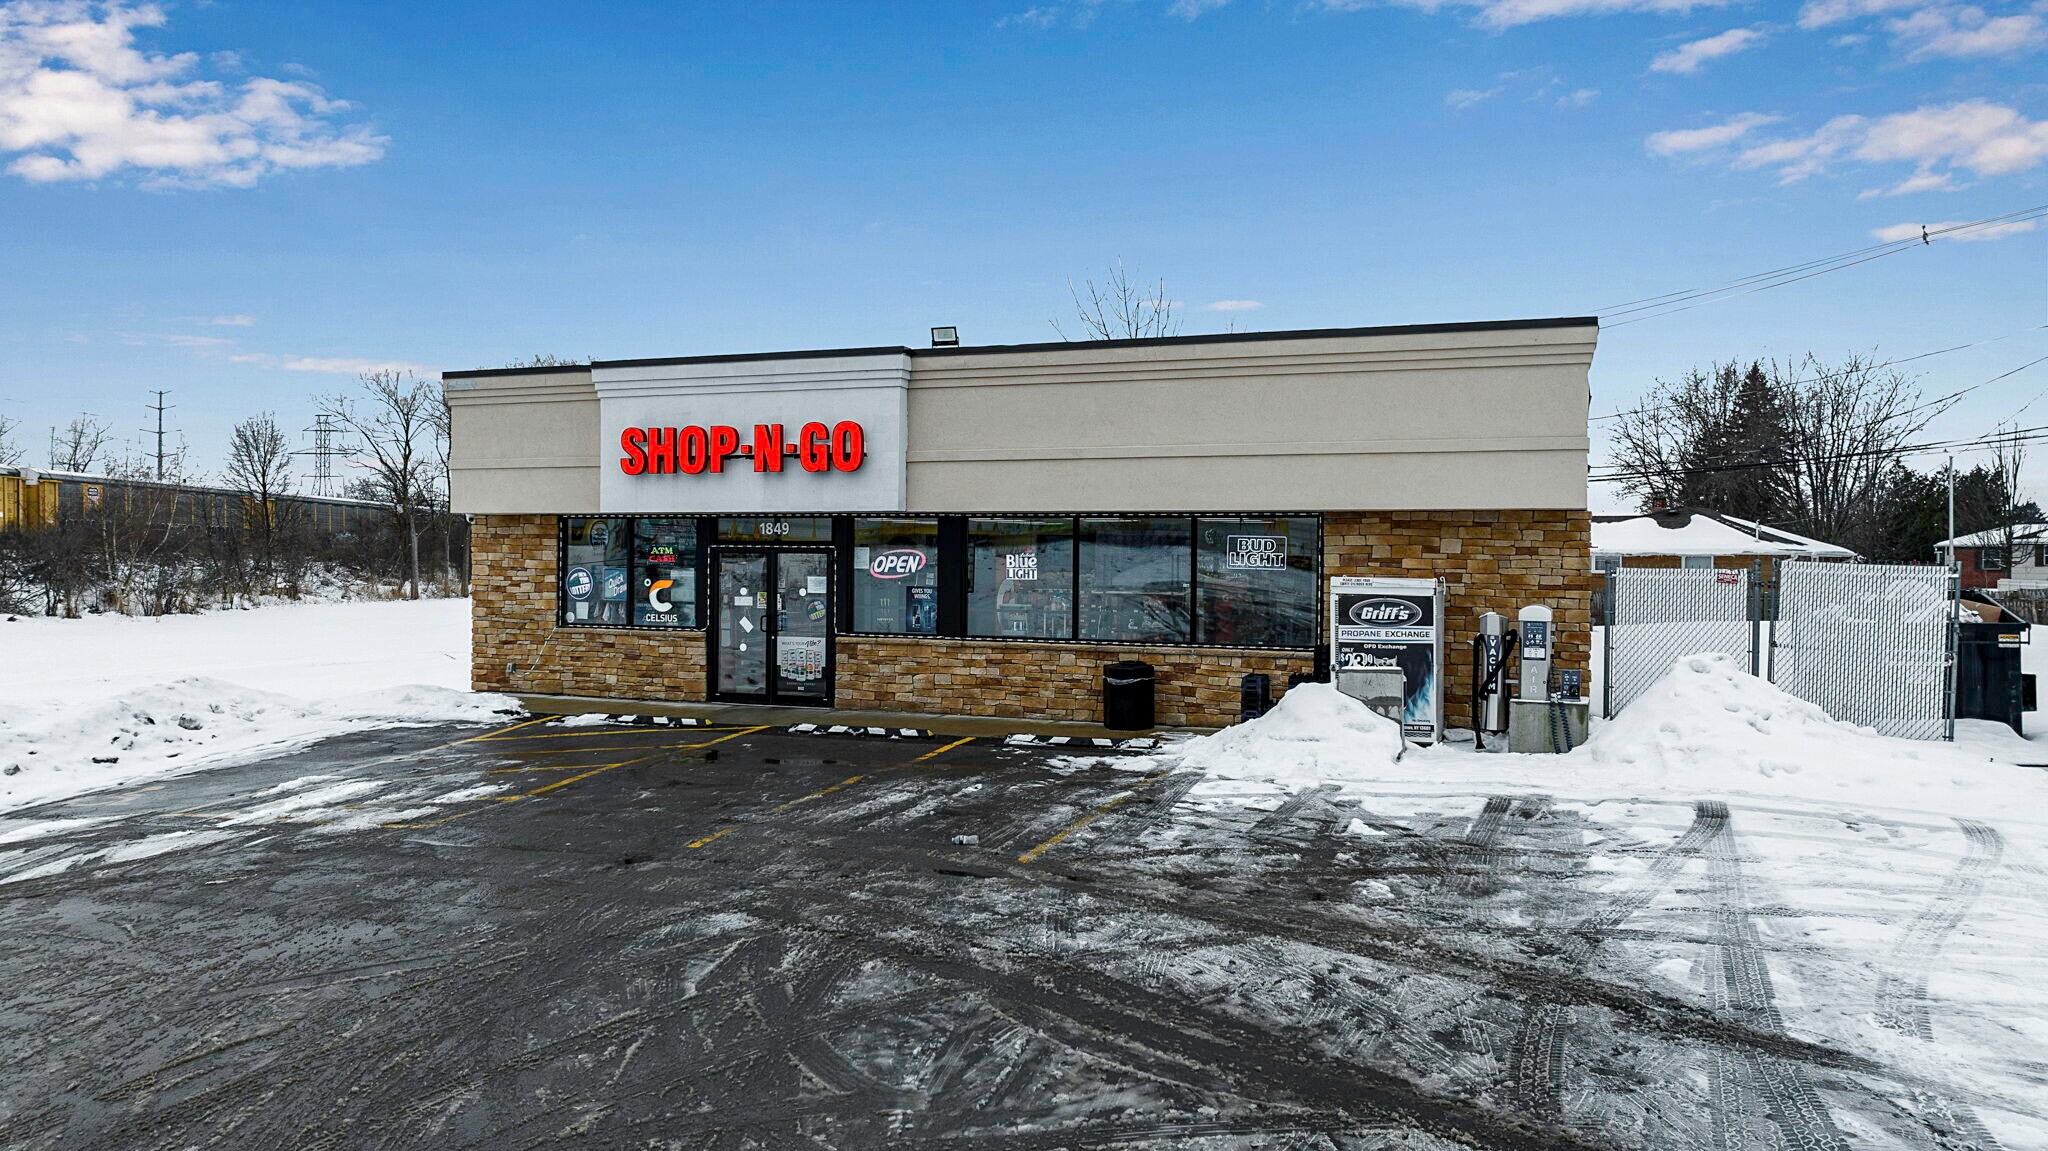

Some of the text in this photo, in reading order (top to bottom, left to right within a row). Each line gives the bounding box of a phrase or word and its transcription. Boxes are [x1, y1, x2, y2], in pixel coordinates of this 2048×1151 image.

[760, 522, 789, 535] 1849
[1238, 539, 1276, 552] BUD
[874, 556, 920, 573] OPEN
[1006, 554, 1037, 568] Blue
[1006, 568, 1037, 579] LIGHT
[608, 574, 624, 589] Quick
[645, 613, 678, 623] CELSIUS
[1341, 630, 1430, 638] PROPANE EXCHANGE
[1487, 639, 1496, 690] VACUM
[1530, 665, 1538, 694] AIR
